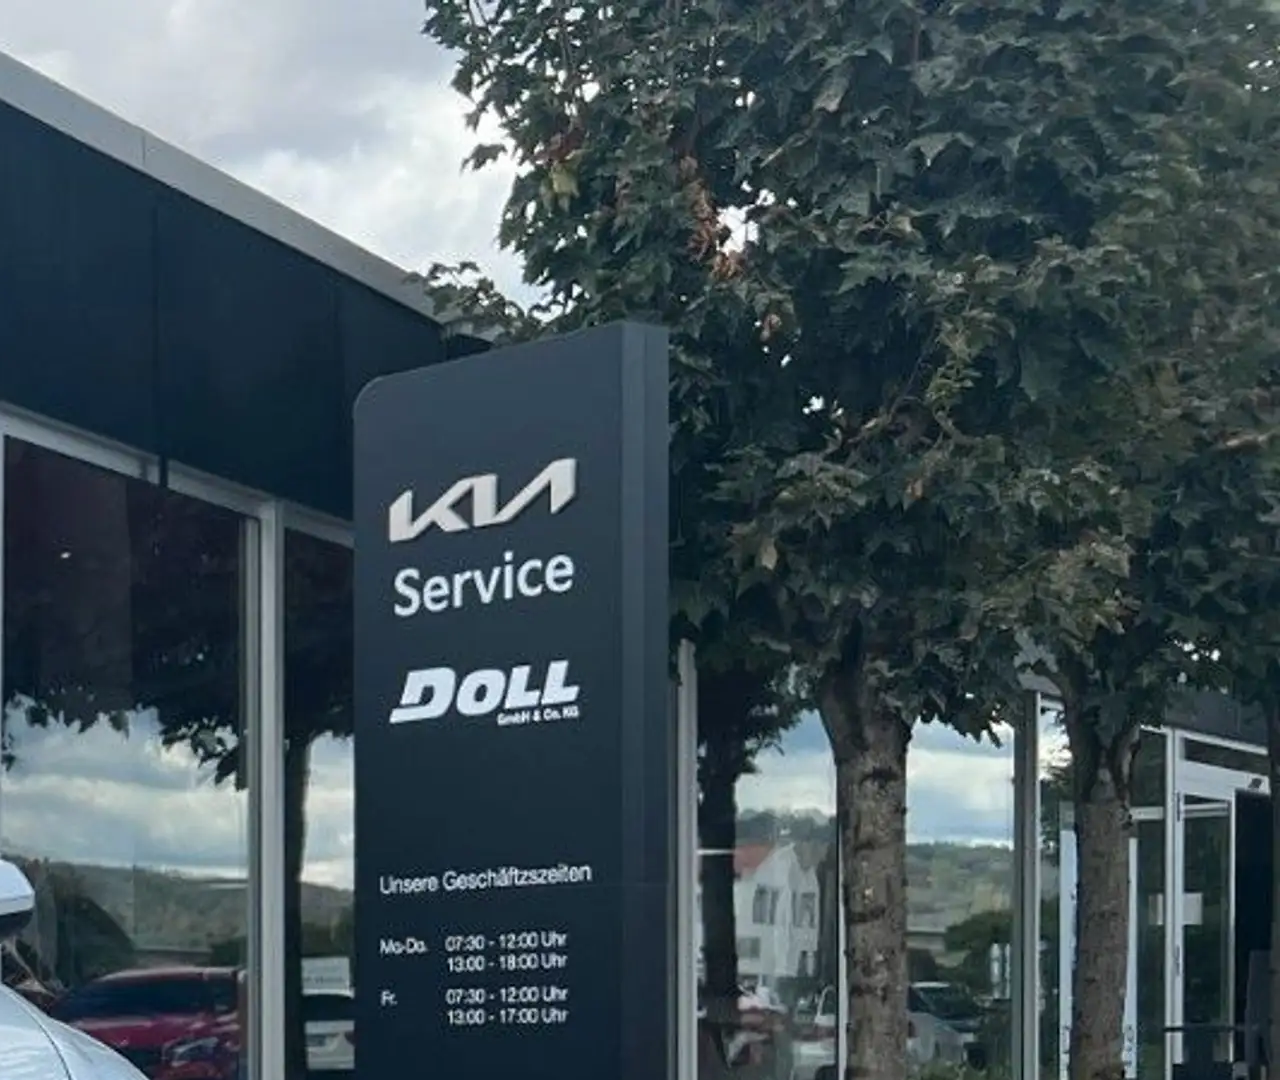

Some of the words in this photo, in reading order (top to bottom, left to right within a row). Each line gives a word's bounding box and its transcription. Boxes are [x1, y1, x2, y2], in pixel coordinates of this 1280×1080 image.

[389, 458, 577, 543] KIA
[393, 550, 575, 617] Service
[389, 660, 580, 724] DOLL
[497, 710, 530, 726] GmbH
[533, 709, 541, 722] &
[563, 705, 579, 719] KG
[380, 875, 438, 894] Unsere
[444, 936, 485, 951] 07:30
[499, 933, 538, 949] 12:00
[541, 932, 567, 947] Uhr
[447, 957, 485, 972] 13:00
[500, 954, 538, 970] 18:00
[541, 953, 567, 968] Uhr
[445, 988, 485, 1004] 07:30
[500, 987, 538, 1003] 12:00
[542, 986, 568, 1001] Uhr
[447, 1010, 485, 1025] 13:00
[500, 1008, 538, 1024] 17:00
[542, 1008, 568, 1023] Uhr
